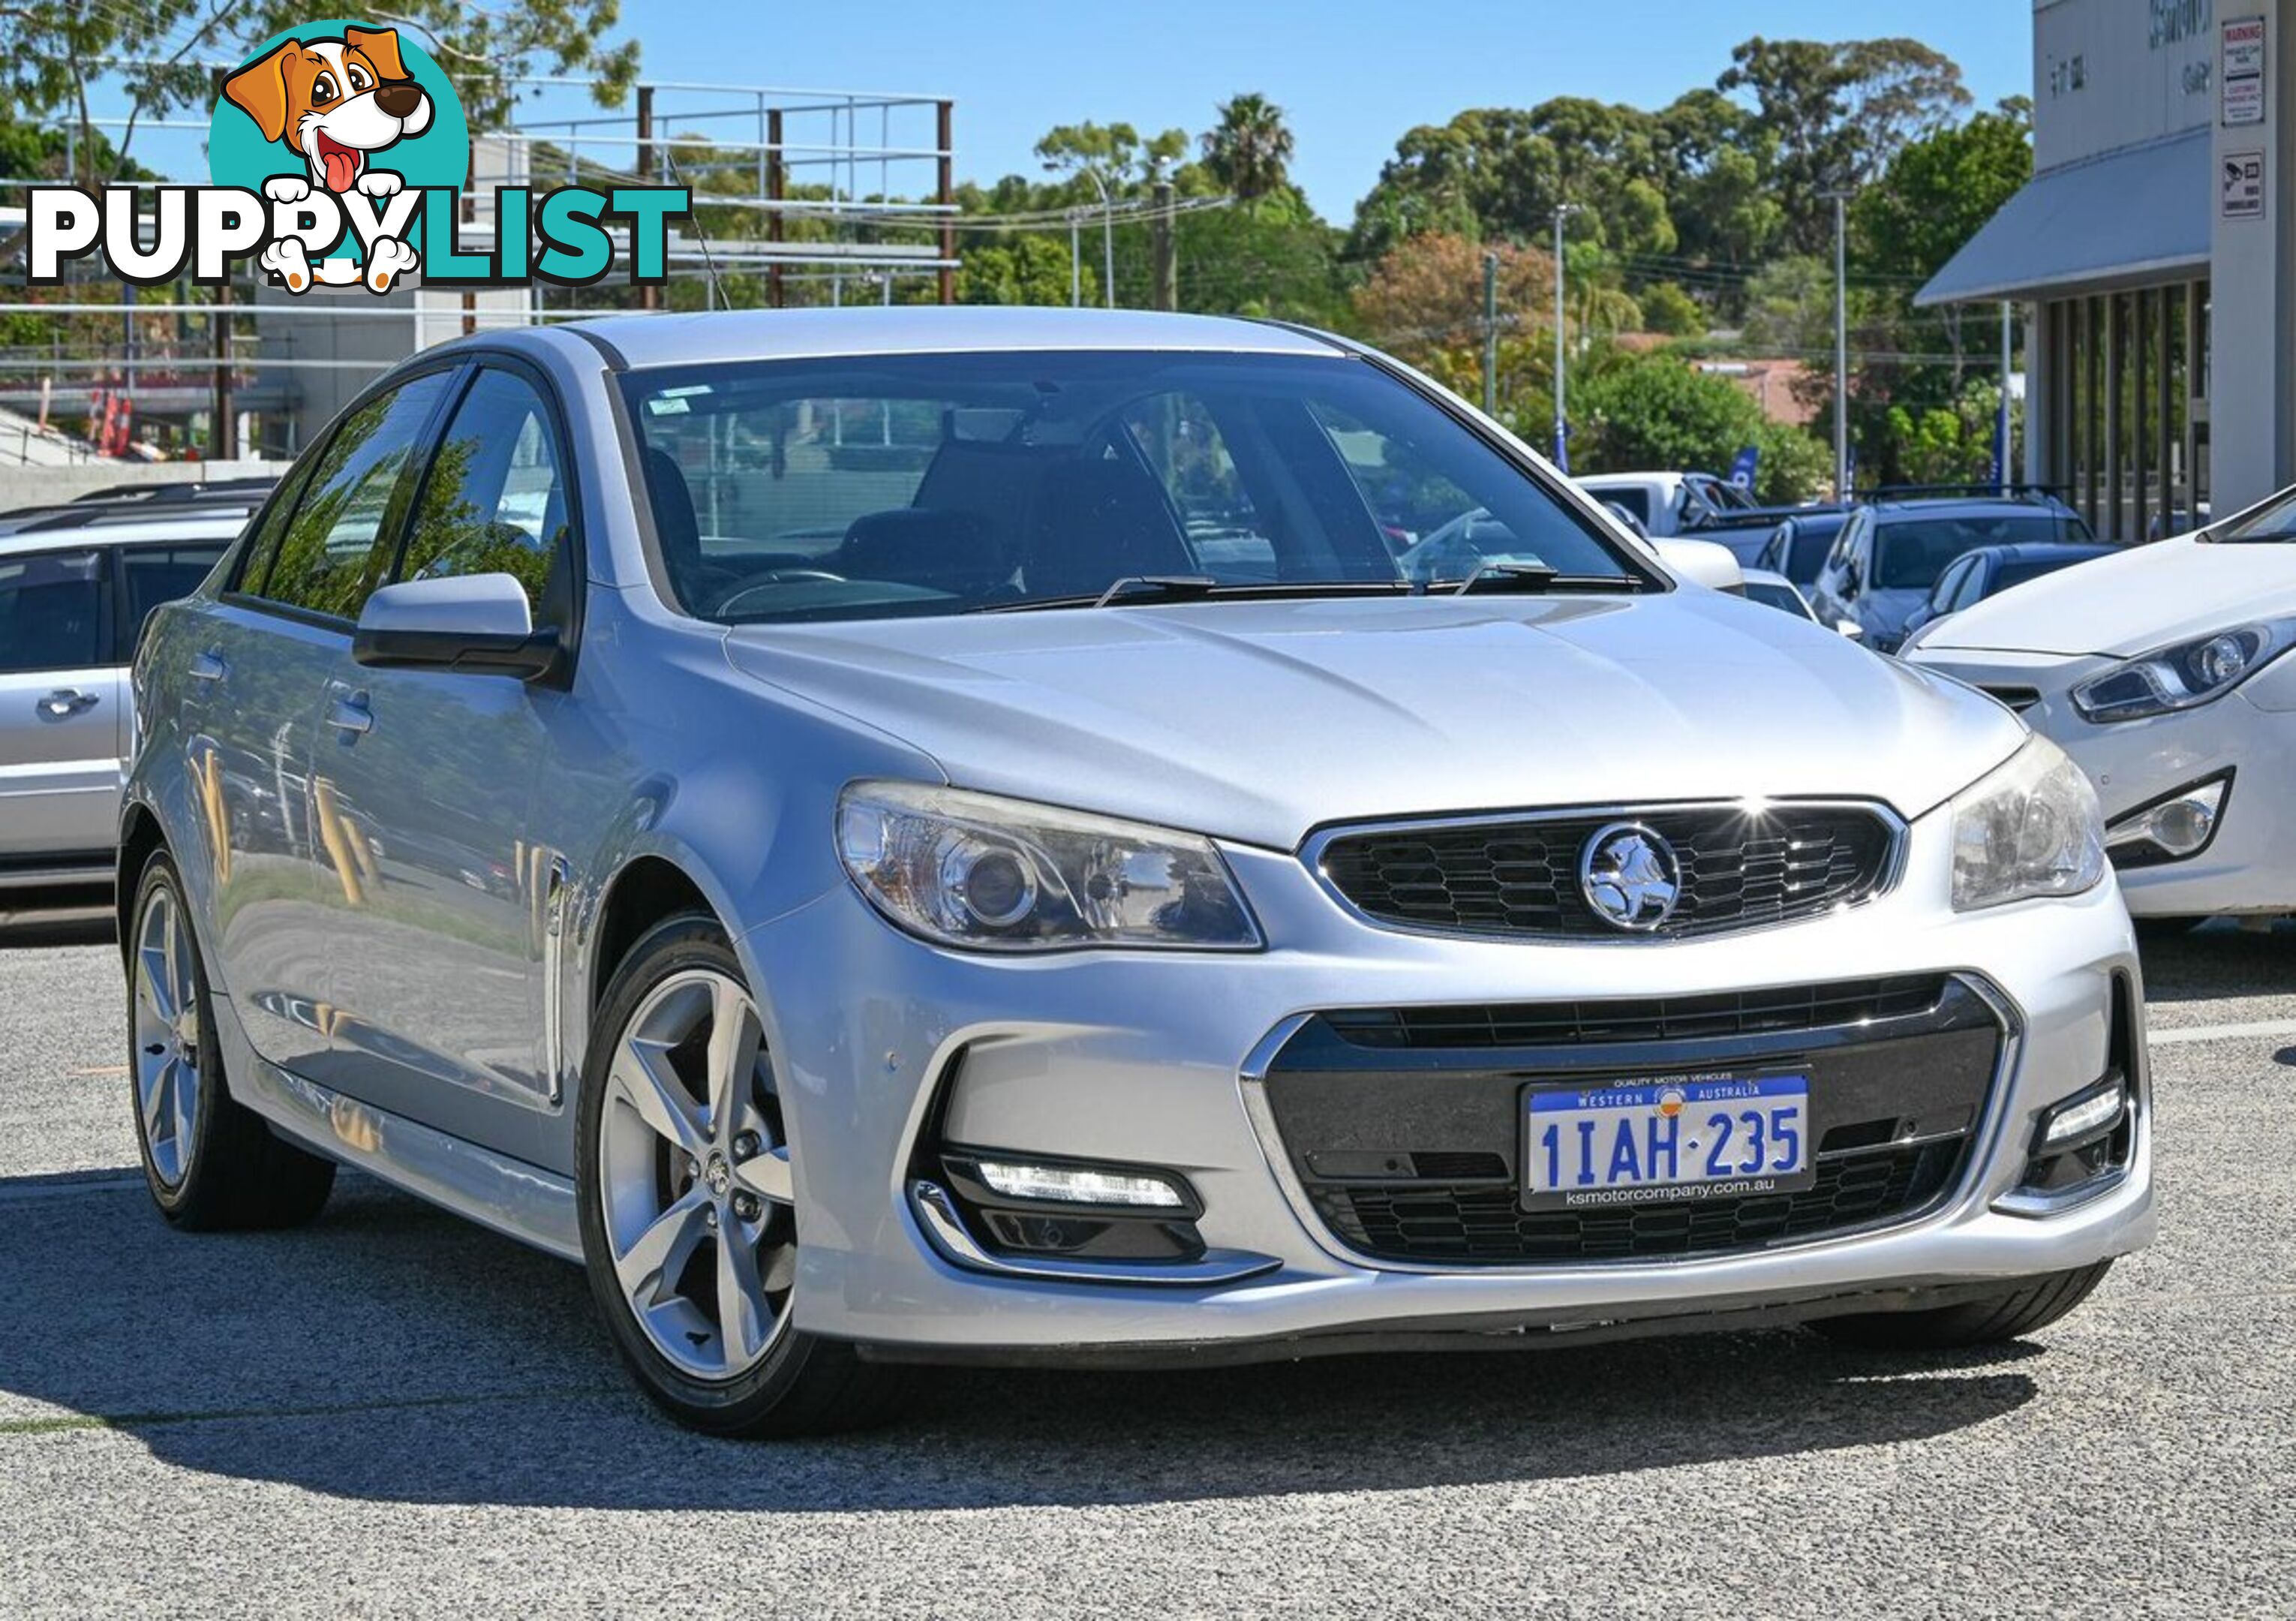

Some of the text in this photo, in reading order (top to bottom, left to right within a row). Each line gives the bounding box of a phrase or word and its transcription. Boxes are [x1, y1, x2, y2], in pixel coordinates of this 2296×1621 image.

[1614, 1072, 1733, 1087] QUALITY MOTOR VEHICLES
[1578, 1085, 1760, 1107] WESTERN AUSTRALIA
[1566, 1178, 1775, 1205] ksmotorcompany.com.au
